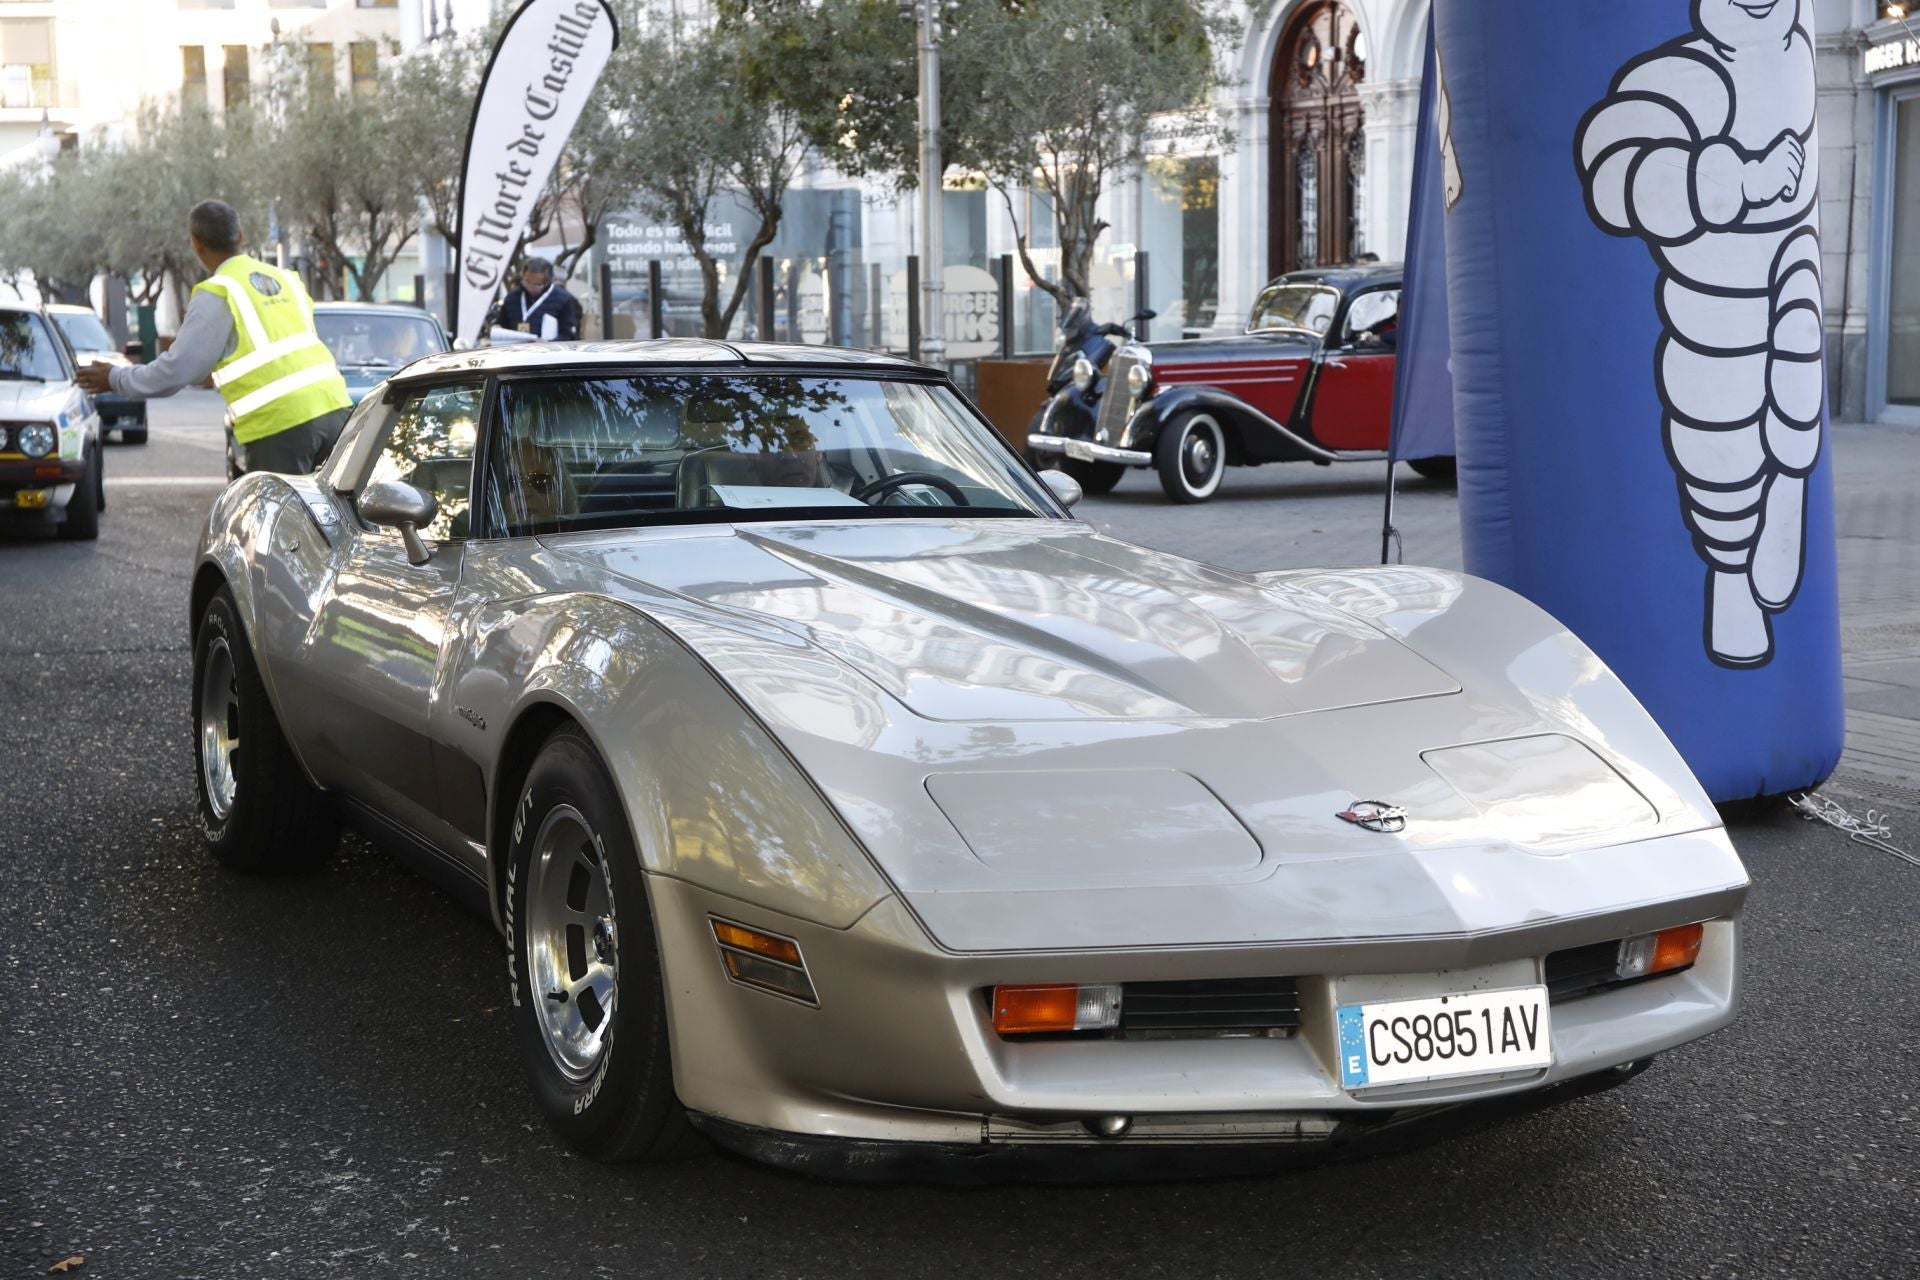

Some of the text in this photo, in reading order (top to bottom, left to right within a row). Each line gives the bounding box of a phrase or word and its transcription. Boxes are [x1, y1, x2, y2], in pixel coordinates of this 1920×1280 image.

[465, 1, 600, 291] El Norte de Castilla
[606, 223, 643, 238] Todo
[645, 226, 664, 238] es
[607, 240, 662, 255] cuando
[515, 787, 534, 845] G/T
[505, 862, 521, 1007] RADIAL
[1348, 1055, 1362, 1074] E
[1369, 1003, 1539, 1067] CS8951AV
[574, 1030, 615, 1115] COBRA
